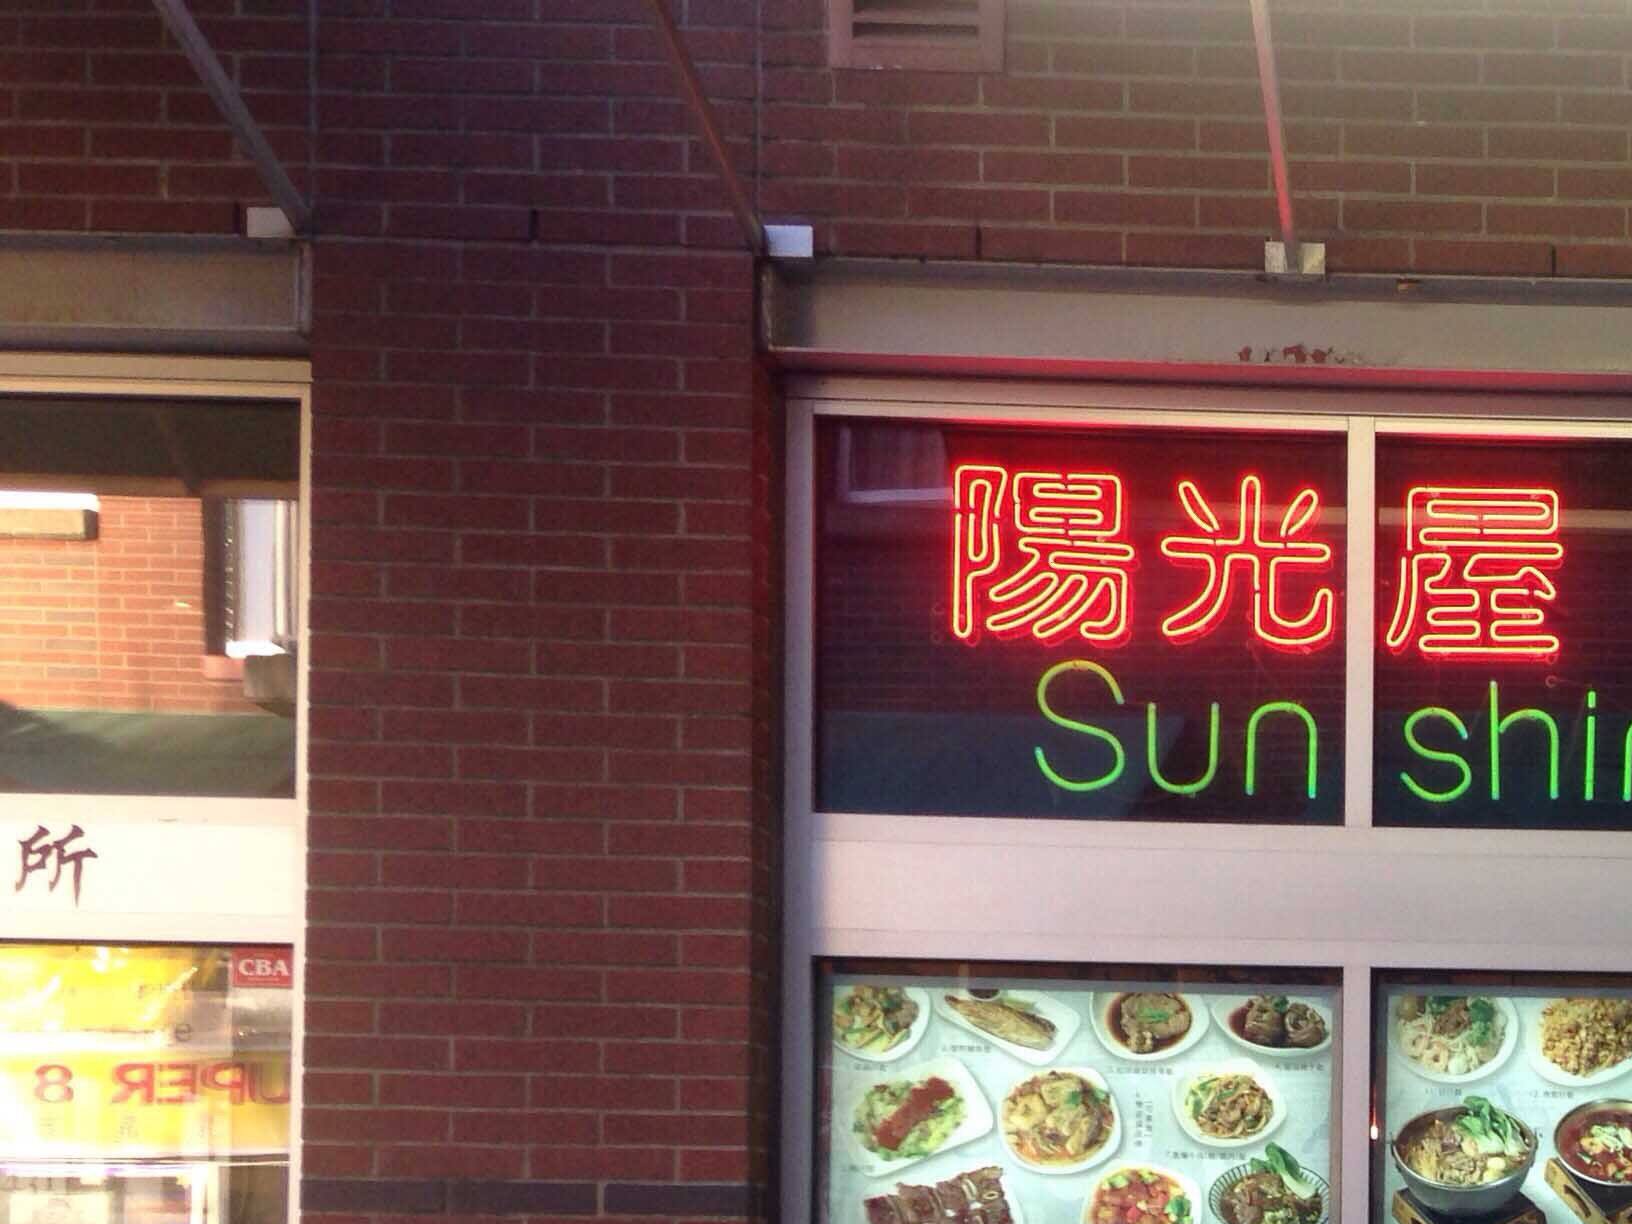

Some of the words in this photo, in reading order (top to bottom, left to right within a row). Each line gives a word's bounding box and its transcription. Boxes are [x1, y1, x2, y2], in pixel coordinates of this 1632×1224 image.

[951, 463, 1566, 656] 陽光屋
[14, 824, 98, 907] 所
[238, 958, 290, 977] CBA
